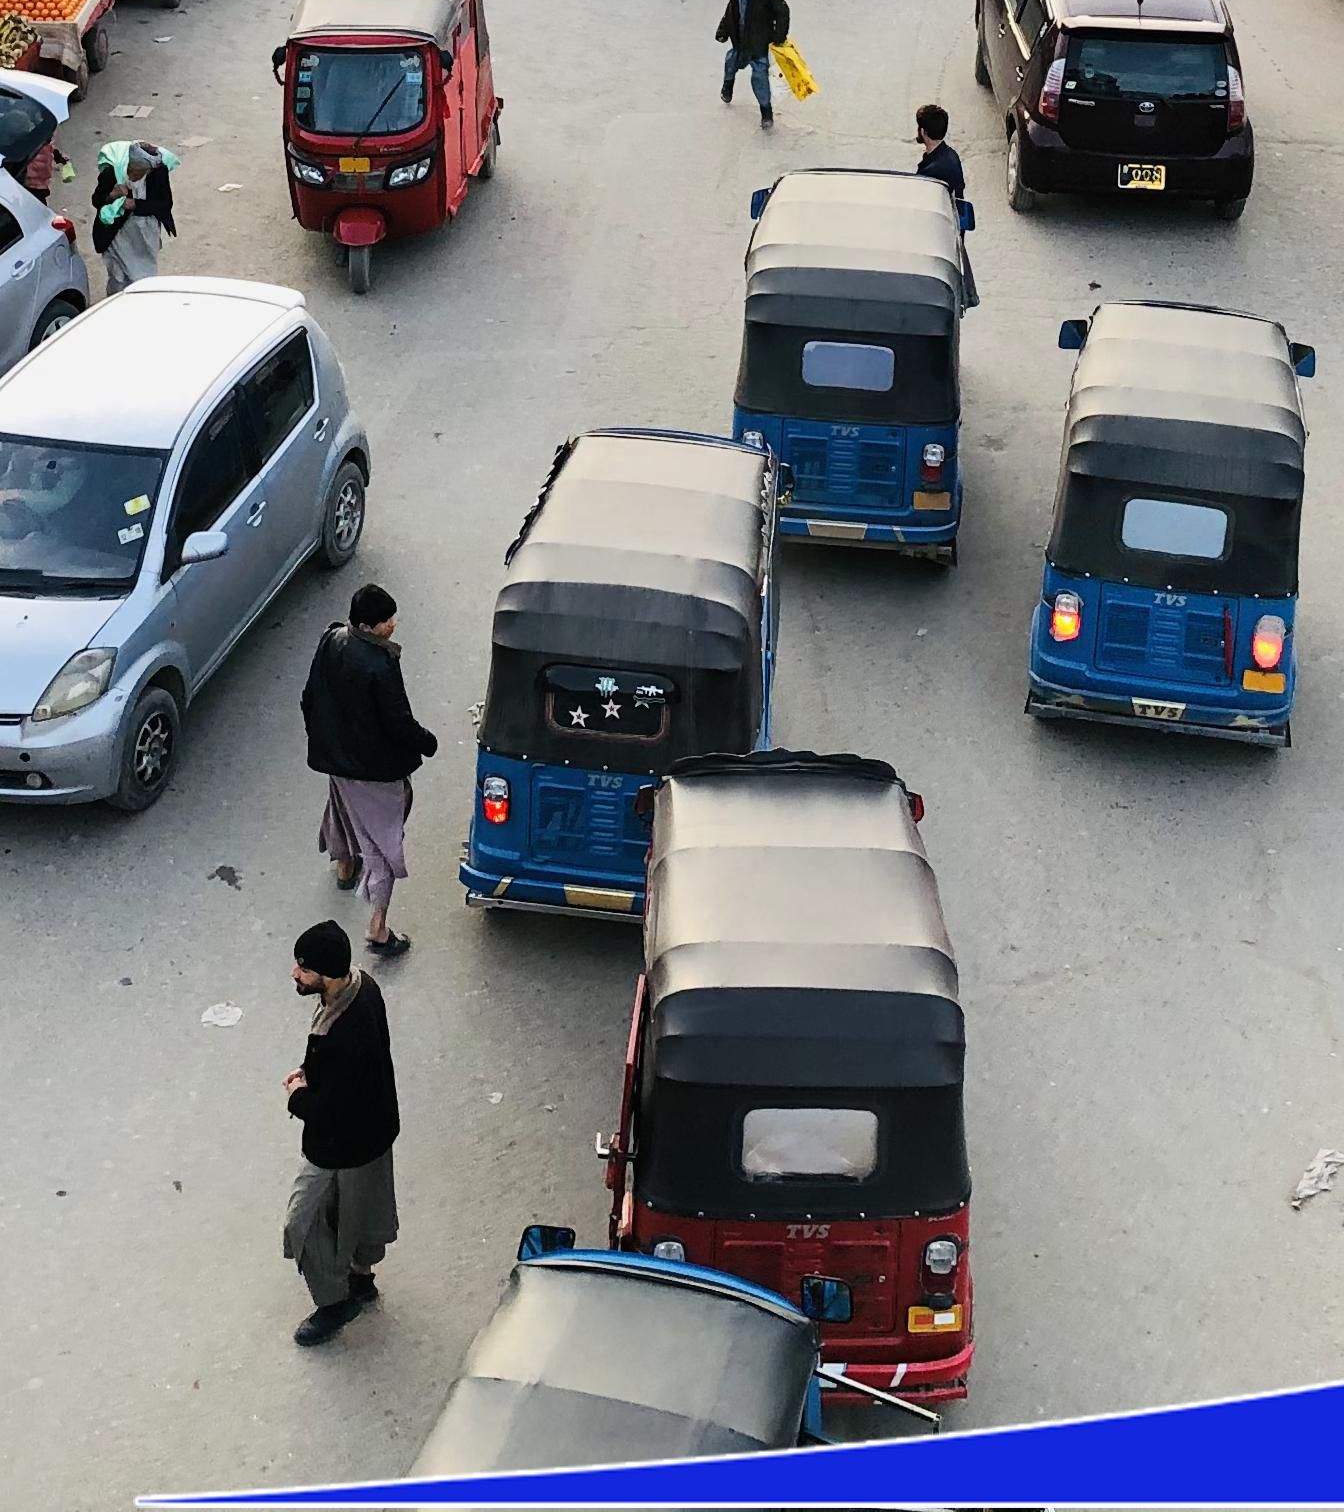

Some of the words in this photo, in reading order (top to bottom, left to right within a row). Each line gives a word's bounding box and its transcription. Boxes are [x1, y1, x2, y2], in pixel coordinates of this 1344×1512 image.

[831, 425, 861, 437] TVS
[1153, 592, 1188, 607] TVS
[1138, 704, 1179, 719] TVS
[587, 774, 624, 789] TVS
[786, 1224, 832, 1240] TVS
